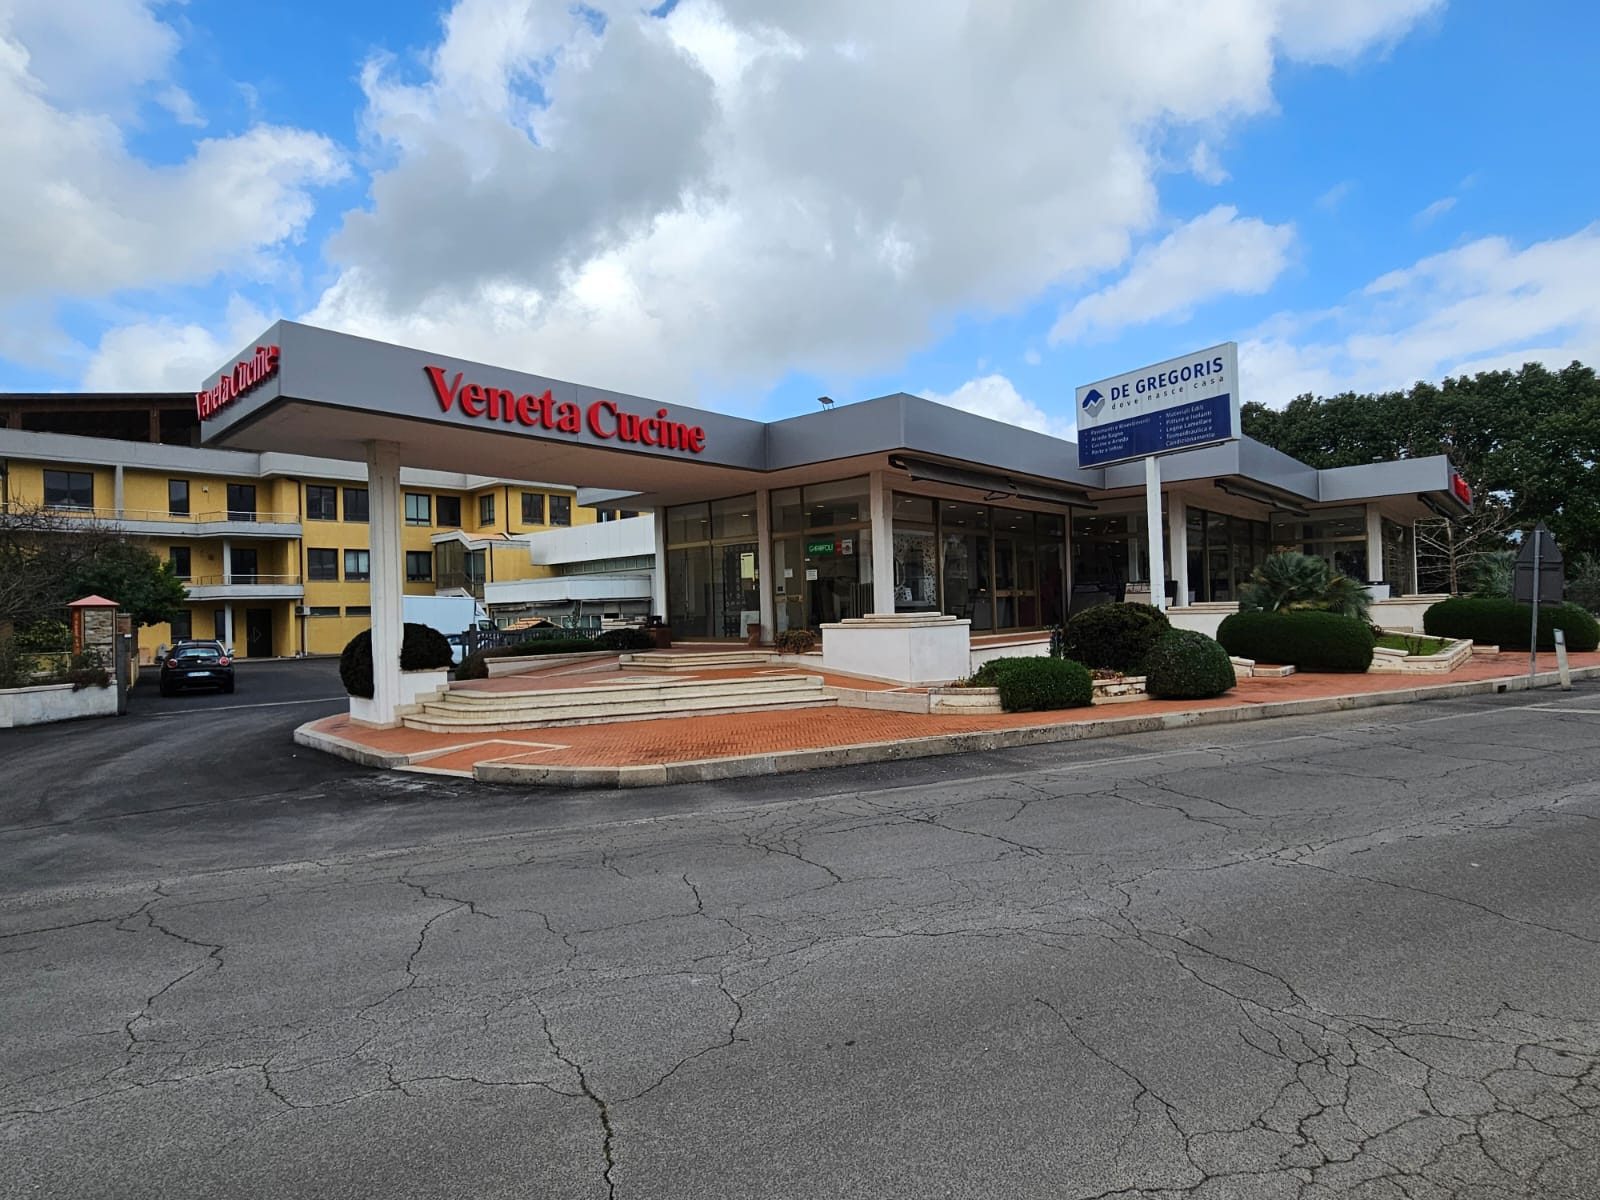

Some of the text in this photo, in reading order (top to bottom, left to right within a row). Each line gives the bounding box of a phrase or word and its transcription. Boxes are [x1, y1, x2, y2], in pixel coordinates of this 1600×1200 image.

[195, 345, 281, 421] Veneta Cucine
[1111, 357, 1224, 401] DE GREGORIS
[1111, 375, 1225, 410] dove nasce casa
[424, 365, 706, 454] Veneta Cucine
